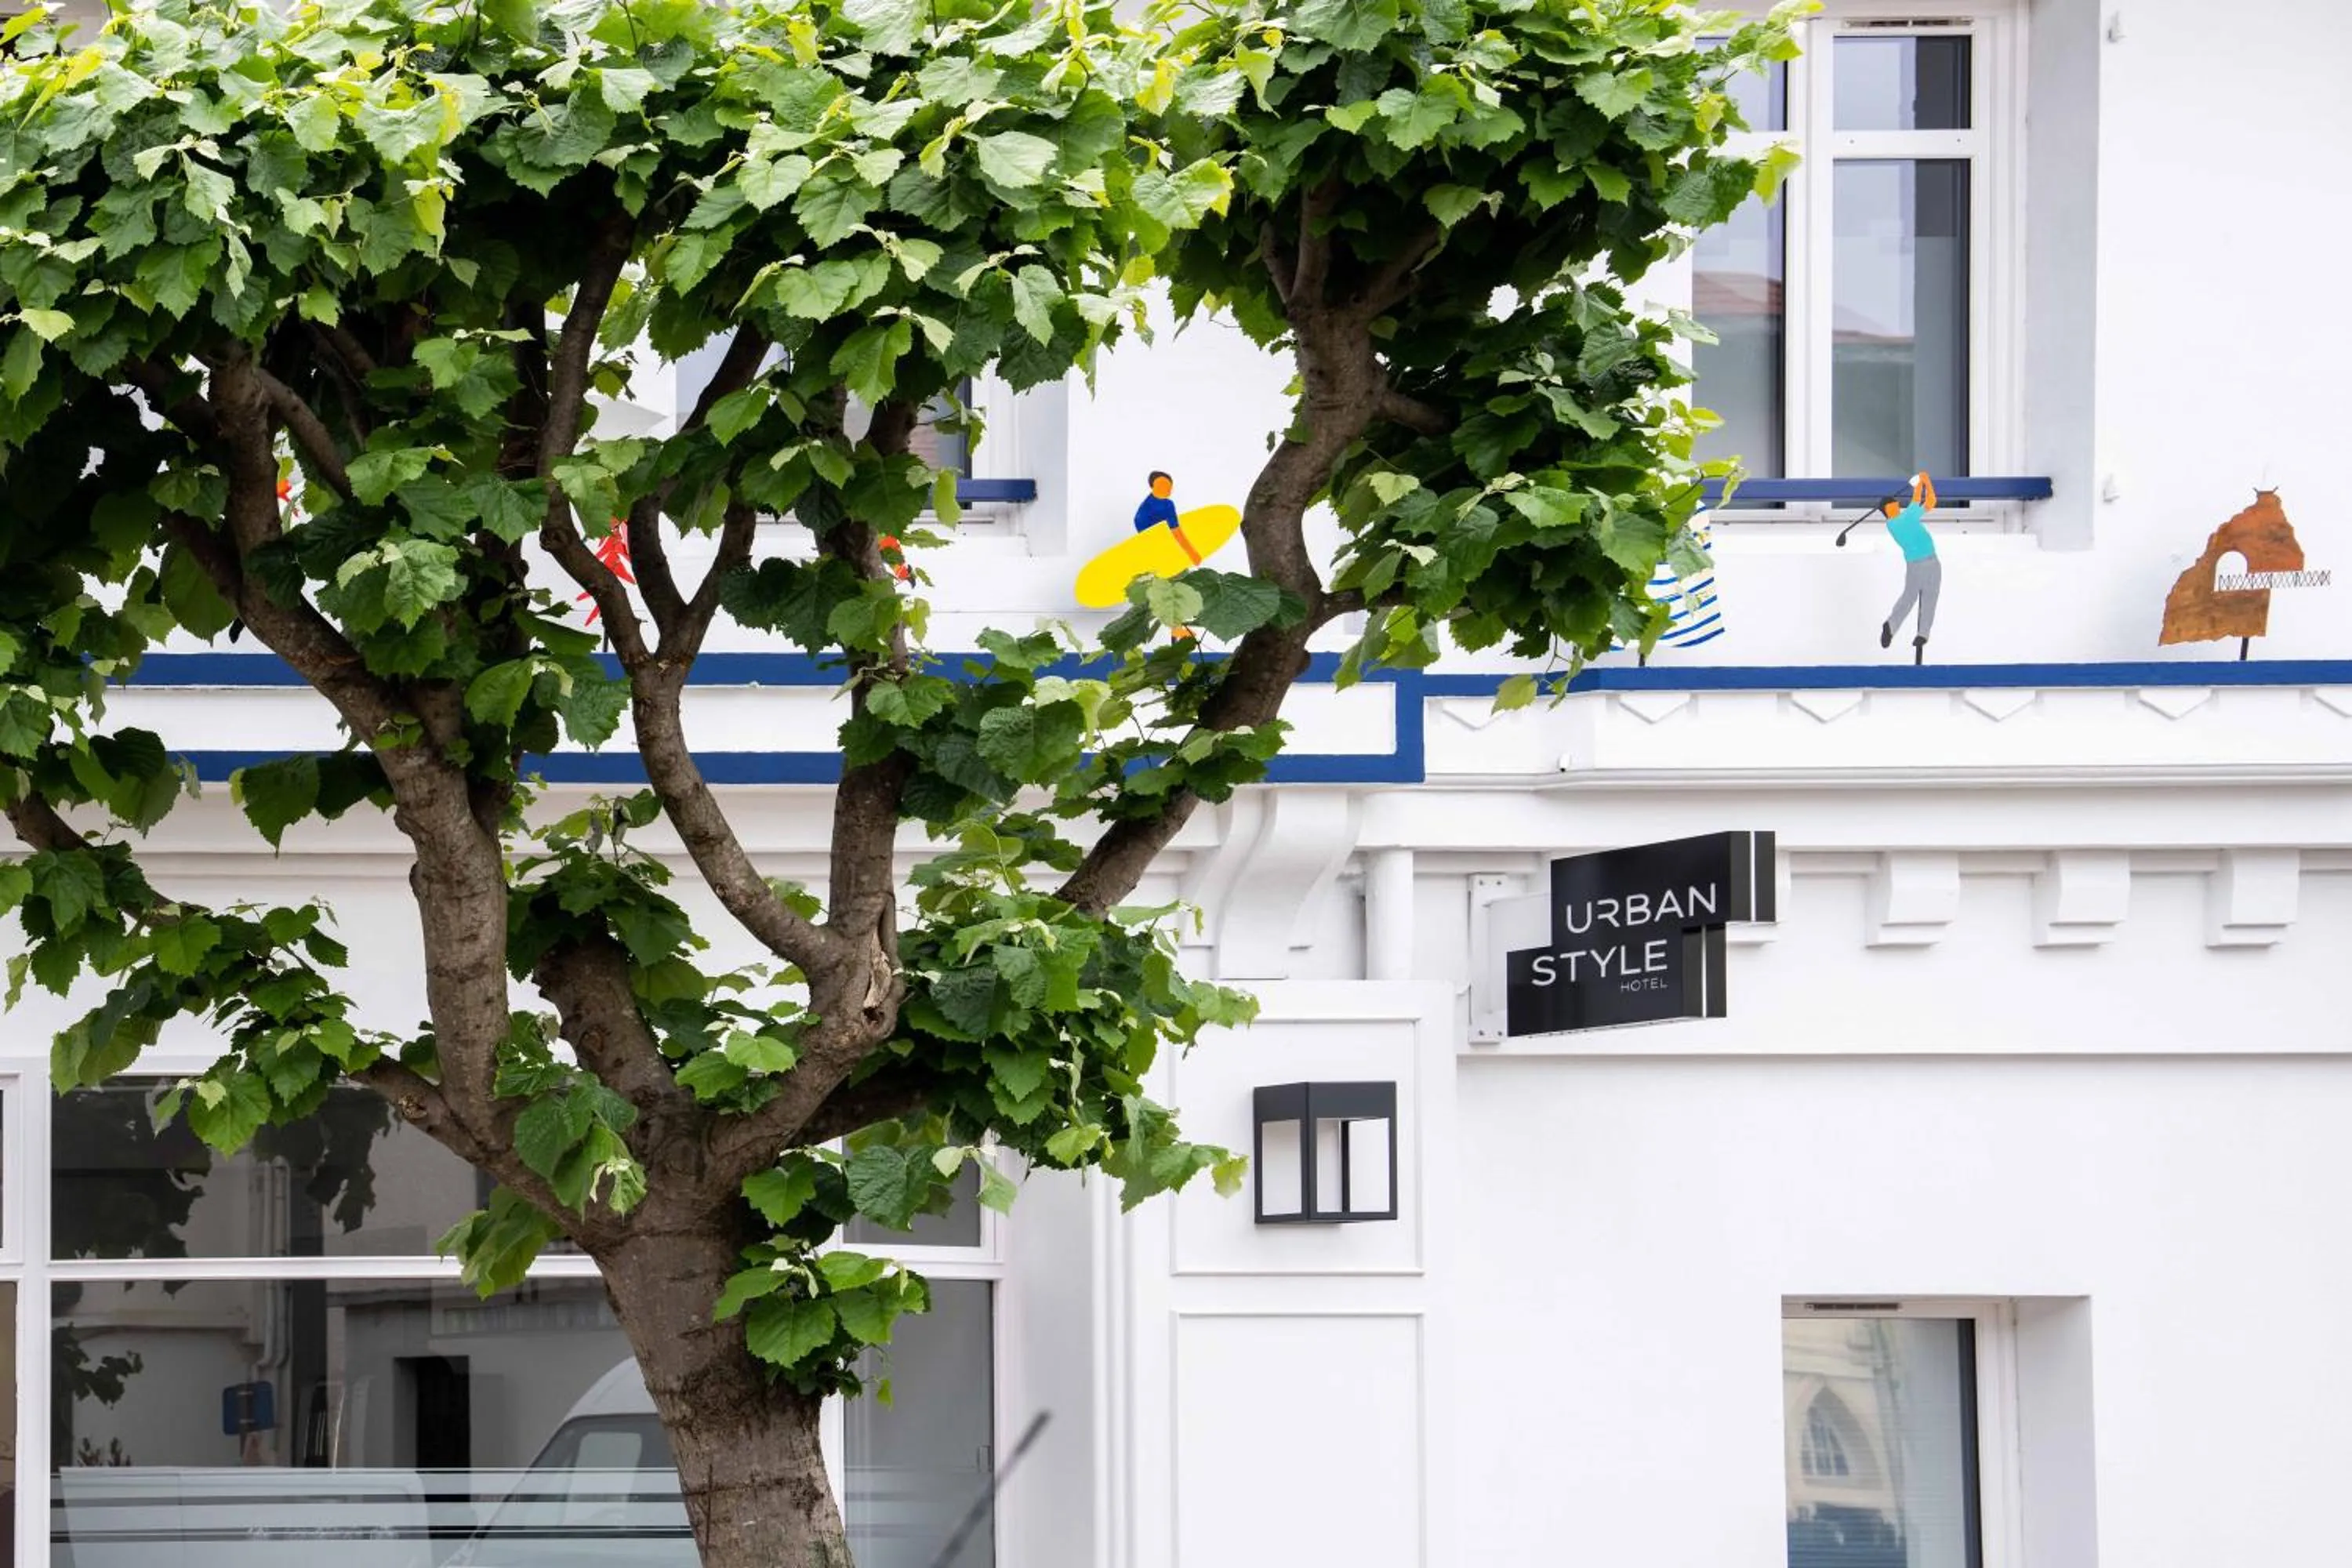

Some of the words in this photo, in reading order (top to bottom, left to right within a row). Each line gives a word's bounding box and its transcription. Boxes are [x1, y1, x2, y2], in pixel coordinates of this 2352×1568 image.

[1566, 883, 1716, 934] URBAN
[1531, 939, 1668, 986] STYLE
[1621, 978, 1668, 993] HOTEL
